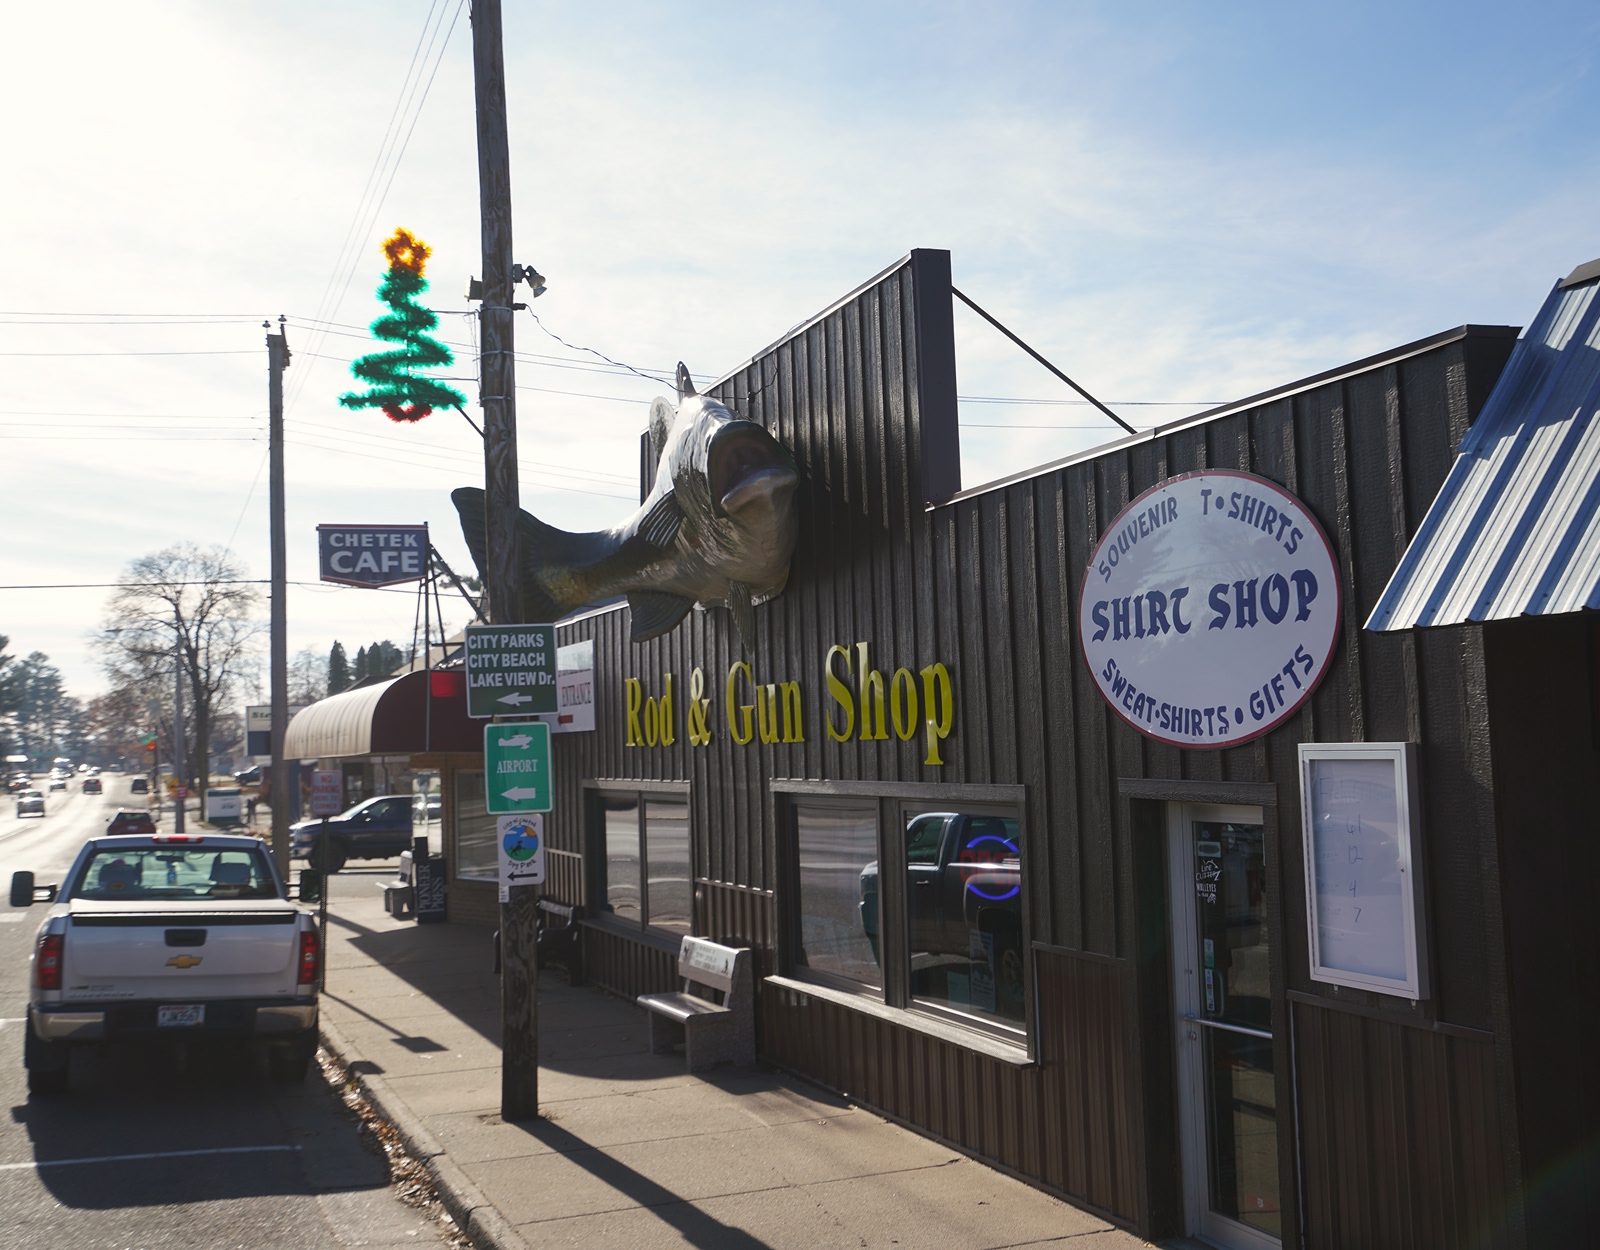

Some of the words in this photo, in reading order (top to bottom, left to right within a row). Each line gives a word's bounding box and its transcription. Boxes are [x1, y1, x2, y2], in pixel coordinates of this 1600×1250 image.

[329, 533, 418, 547] CHETEK
[1098, 496, 1178, 583] SOUVENIR
[330, 550, 419, 573] CAFE
[1092, 586, 1192, 643] SHIRT
[1208, 568, 1319, 632] SHOP
[468, 634, 498, 649] CITY
[501, 633, 544, 648] PARKS
[469, 653, 499, 668] CITY
[502, 652, 545, 667] BEACH
[470, 673, 503, 687] LAKE
[505, 671, 537, 686] VIEW
[539, 671, 555, 685] Dr.
[1249, 644, 1315, 722] GIFTS
[562, 682, 591, 707] ENTRANCE
[624, 672, 675, 748] Rod
[688, 666, 712, 747] &
[726, 660, 805, 745] Gun
[826, 641, 953, 766] Shop
[497, 759, 538, 774] AIRPORT
[320, 775, 333, 783] NO
[1346, 814, 1361, 834] 61
[1348, 845, 1363, 865] 12
[418, 864, 431, 913] PIONEER
[431, 876, 445, 912] PRESS
[1349, 880, 1357, 897] 4
[1353, 906, 1362, 923] 7
